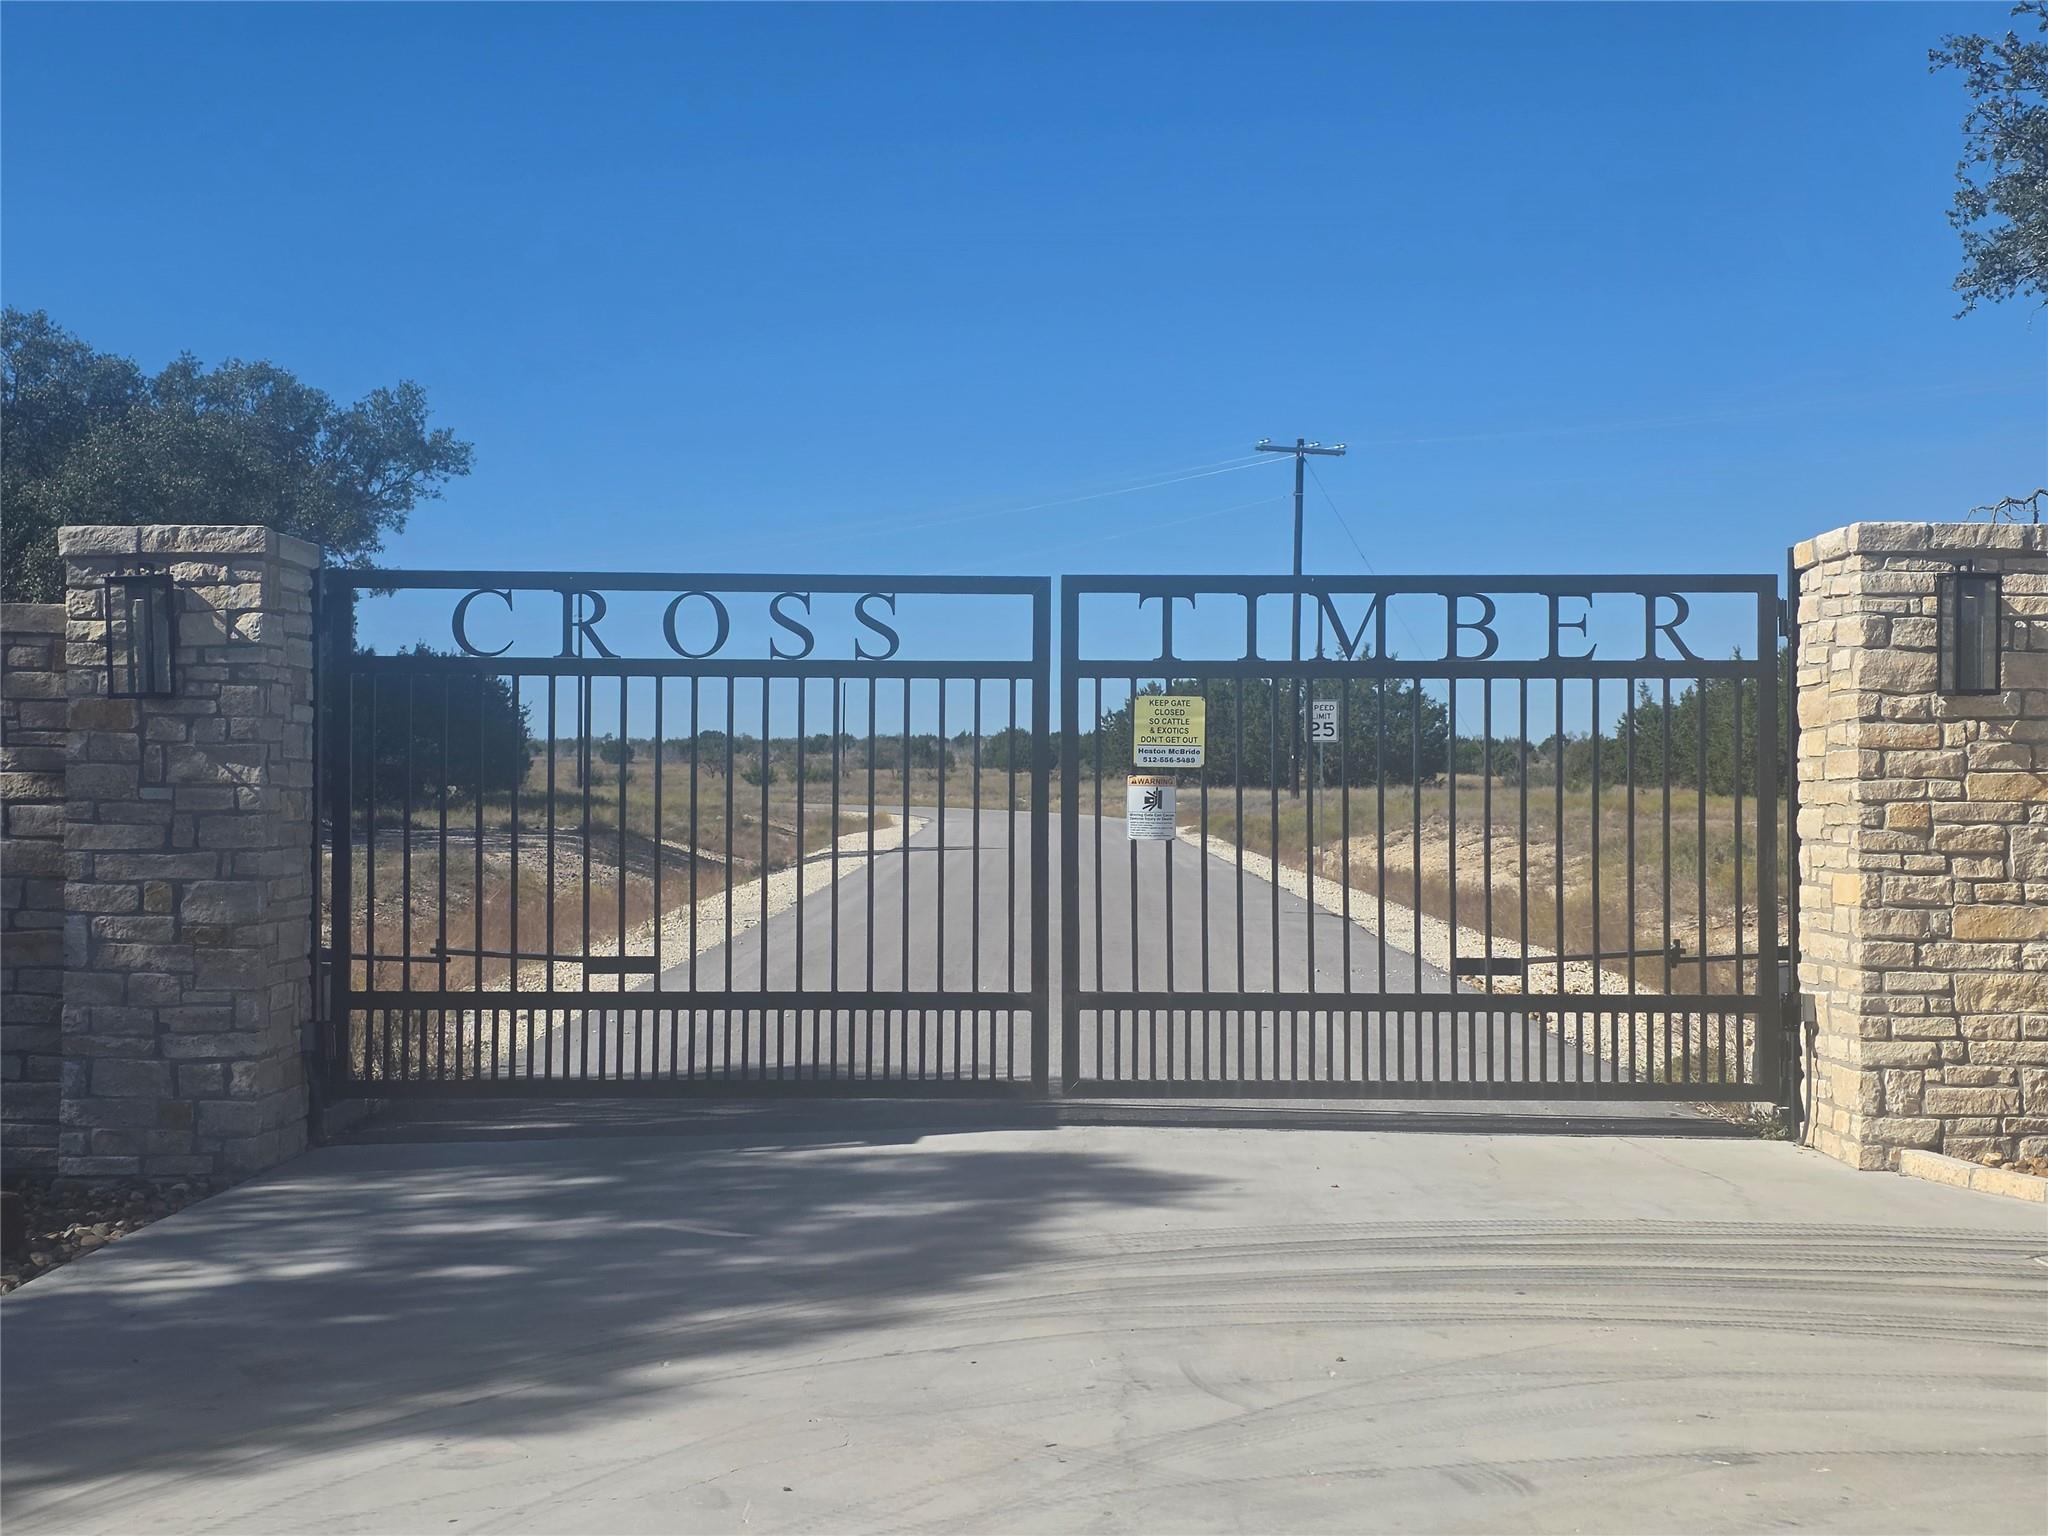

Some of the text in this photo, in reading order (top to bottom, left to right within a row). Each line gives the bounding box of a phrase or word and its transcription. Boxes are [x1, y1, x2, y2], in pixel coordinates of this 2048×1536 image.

[451, 588, 1705, 661] CROSS TIMBER
[1149, 699, 1191, 707] KEEP GATE
[1154, 708, 1185, 716] CLOSED
[1149, 717, 1190, 725] SO CATTLE
[1312, 722, 1335, 737] 25
[1182, 736, 1198, 744] OUT
